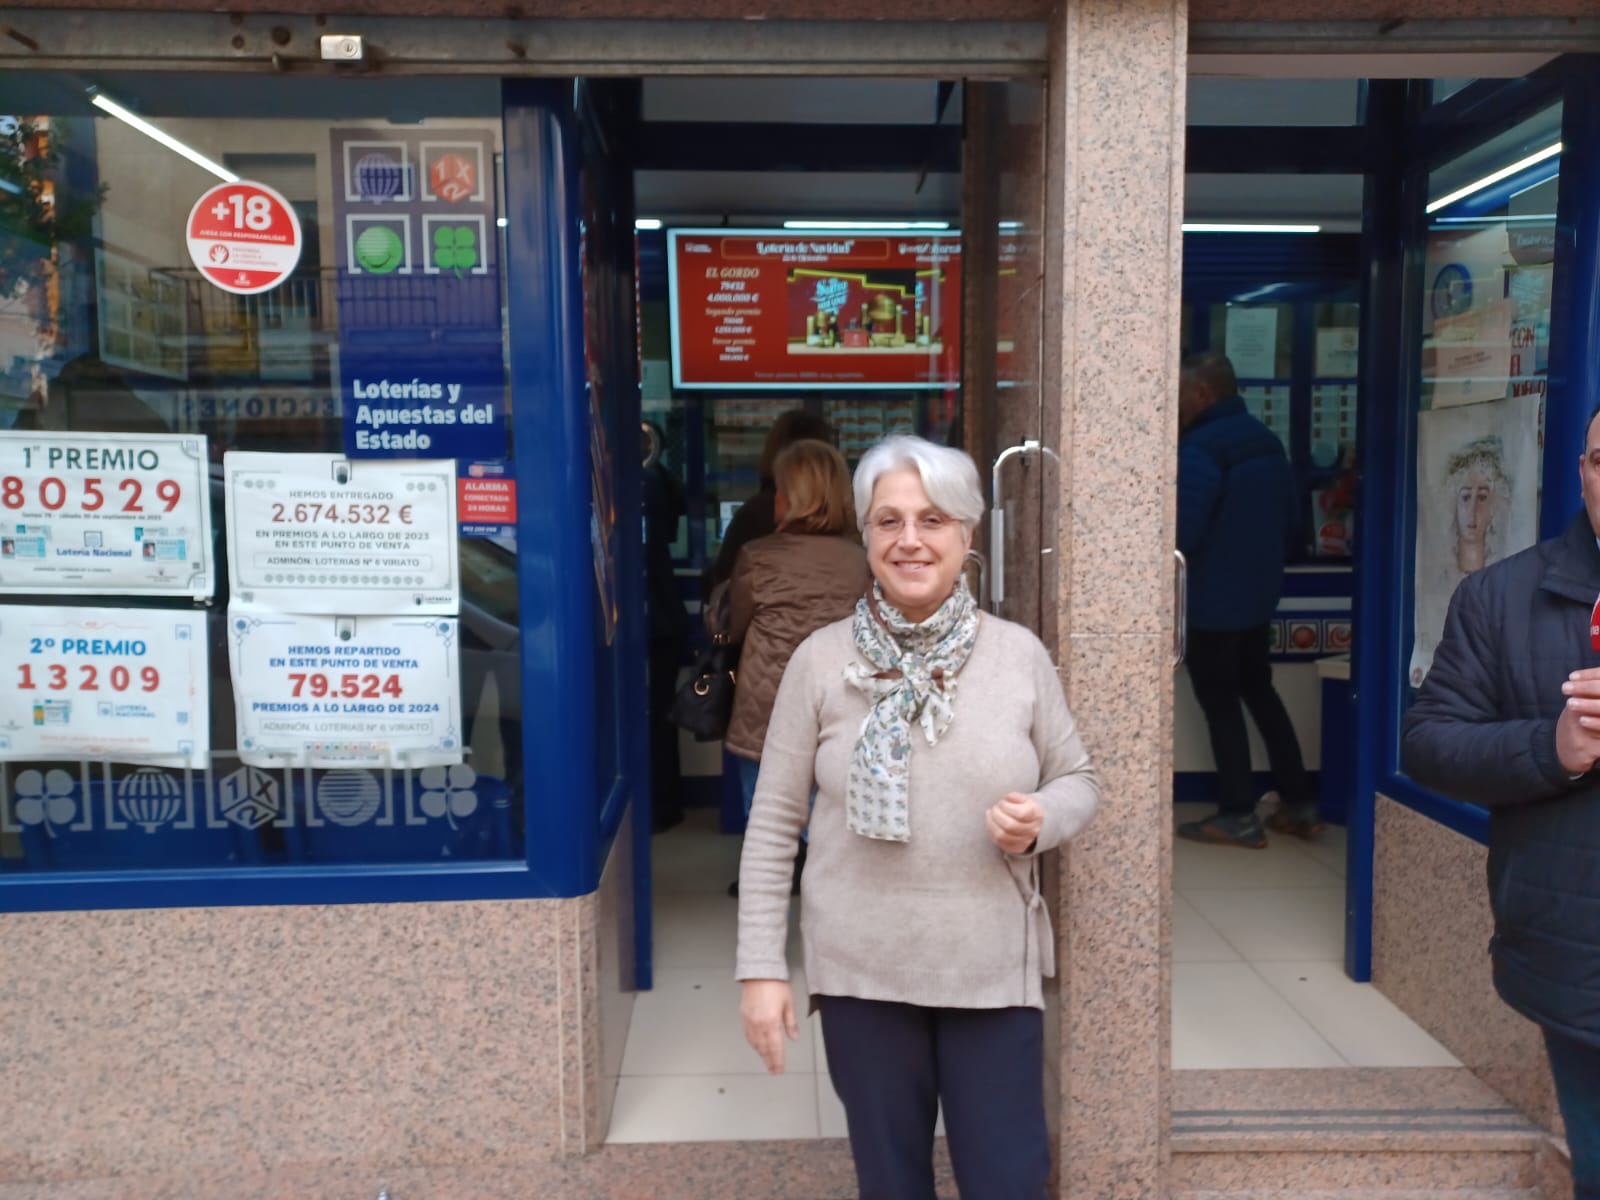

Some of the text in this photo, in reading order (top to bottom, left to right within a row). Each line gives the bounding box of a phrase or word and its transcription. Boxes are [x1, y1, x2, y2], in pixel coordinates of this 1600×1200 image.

[211, 194, 272, 231] +18
[705, 267, 760, 278] EL GORDO
[353, 379, 461, 403] Loterías y
[356, 403, 493, 429] Apuestas del
[356, 430, 431, 450] Estado
[49, 447, 159, 471] PREMIO
[464, 482, 509, 491] ALARMA
[289, 491, 394, 500] HEMOS ENTREGADO
[271, 503, 414, 524] 2.674.532 €
[256, 530, 269, 538] EN
[272, 530, 319, 539] PREMIOS
[332, 531, 346, 539] LO
[349, 532, 385, 540] LARGO
[388, 532, 402, 540] DE
[404, 532, 430, 540] 2023
[275, 540, 411, 550] EN ESTE PUNTO DE VENTA
[93, 548, 132, 557] Nacional
[382, 558, 420, 567] VIRIATO
[62, 639, 147, 656] PREMIO
[288, 645, 401, 655] HEMOS REPARTIDO
[269, 658, 419, 668] EN ESTE PUNTO DE VENTA
[288, 673, 403, 698] 79.524
[252, 702, 440, 713] PREMIOS A LO LARGO DE 2024
[388, 723, 430, 732] VIRIATO
